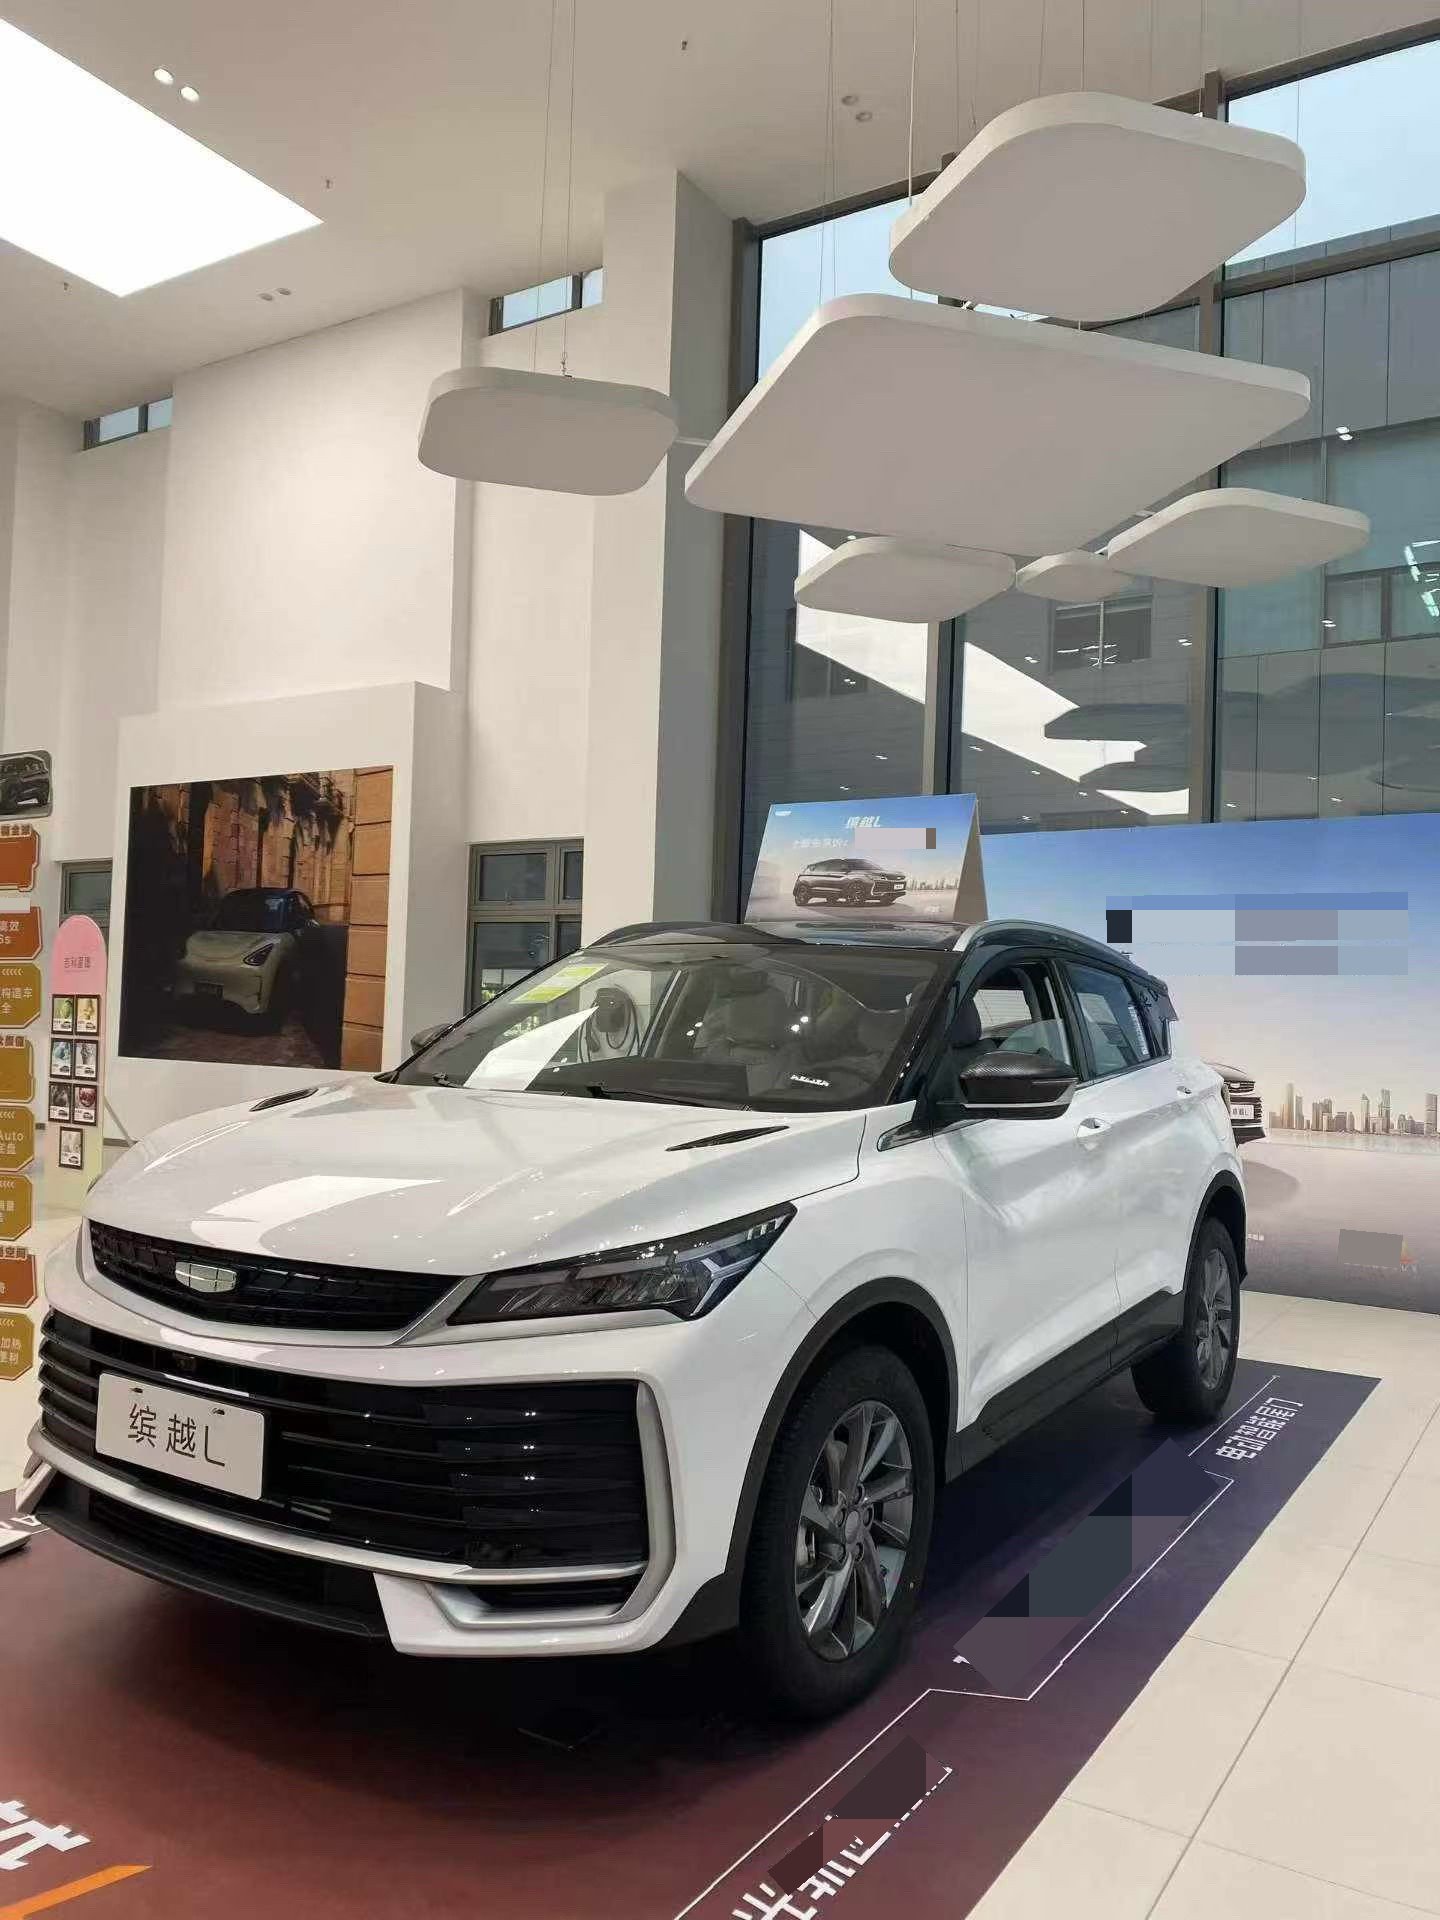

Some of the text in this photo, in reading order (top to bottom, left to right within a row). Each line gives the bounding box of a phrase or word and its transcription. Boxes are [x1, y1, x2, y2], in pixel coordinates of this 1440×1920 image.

[0, 987, 33, 999] 构造车
[0, 1247, 26, 1259] 空间
[127, 1404, 226, 1467] 缤越L
[1215, 1397, 1304, 1460] 电动智能尾门
